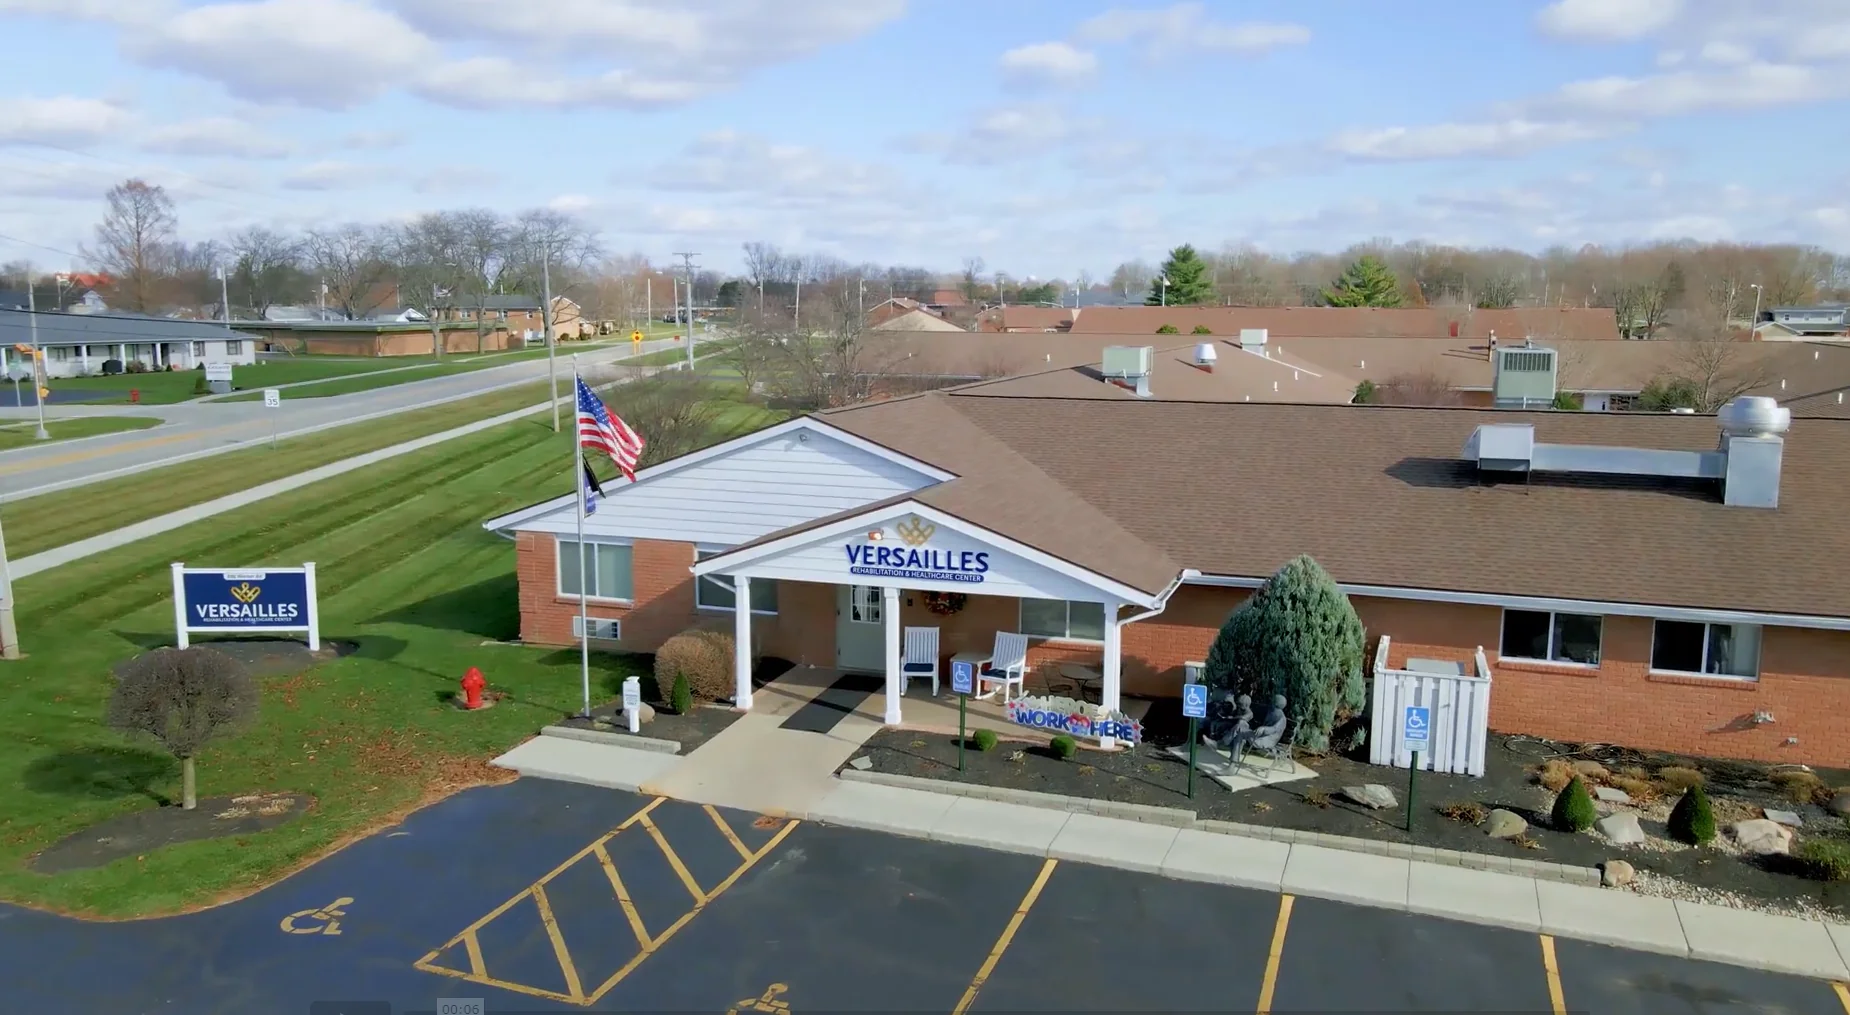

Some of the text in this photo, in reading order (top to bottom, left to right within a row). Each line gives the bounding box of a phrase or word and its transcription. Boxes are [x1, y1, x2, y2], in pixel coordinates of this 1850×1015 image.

[845, 544, 990, 573] VERSAILLES
[852, 567, 904, 577] REHABILITATION
[911, 571, 953, 580] HEALTHCARE
[954, 574, 981, 582] CENTER
[196, 603, 298, 617] VERSAILLES
[1016, 708, 1133, 741] WORK HERE
